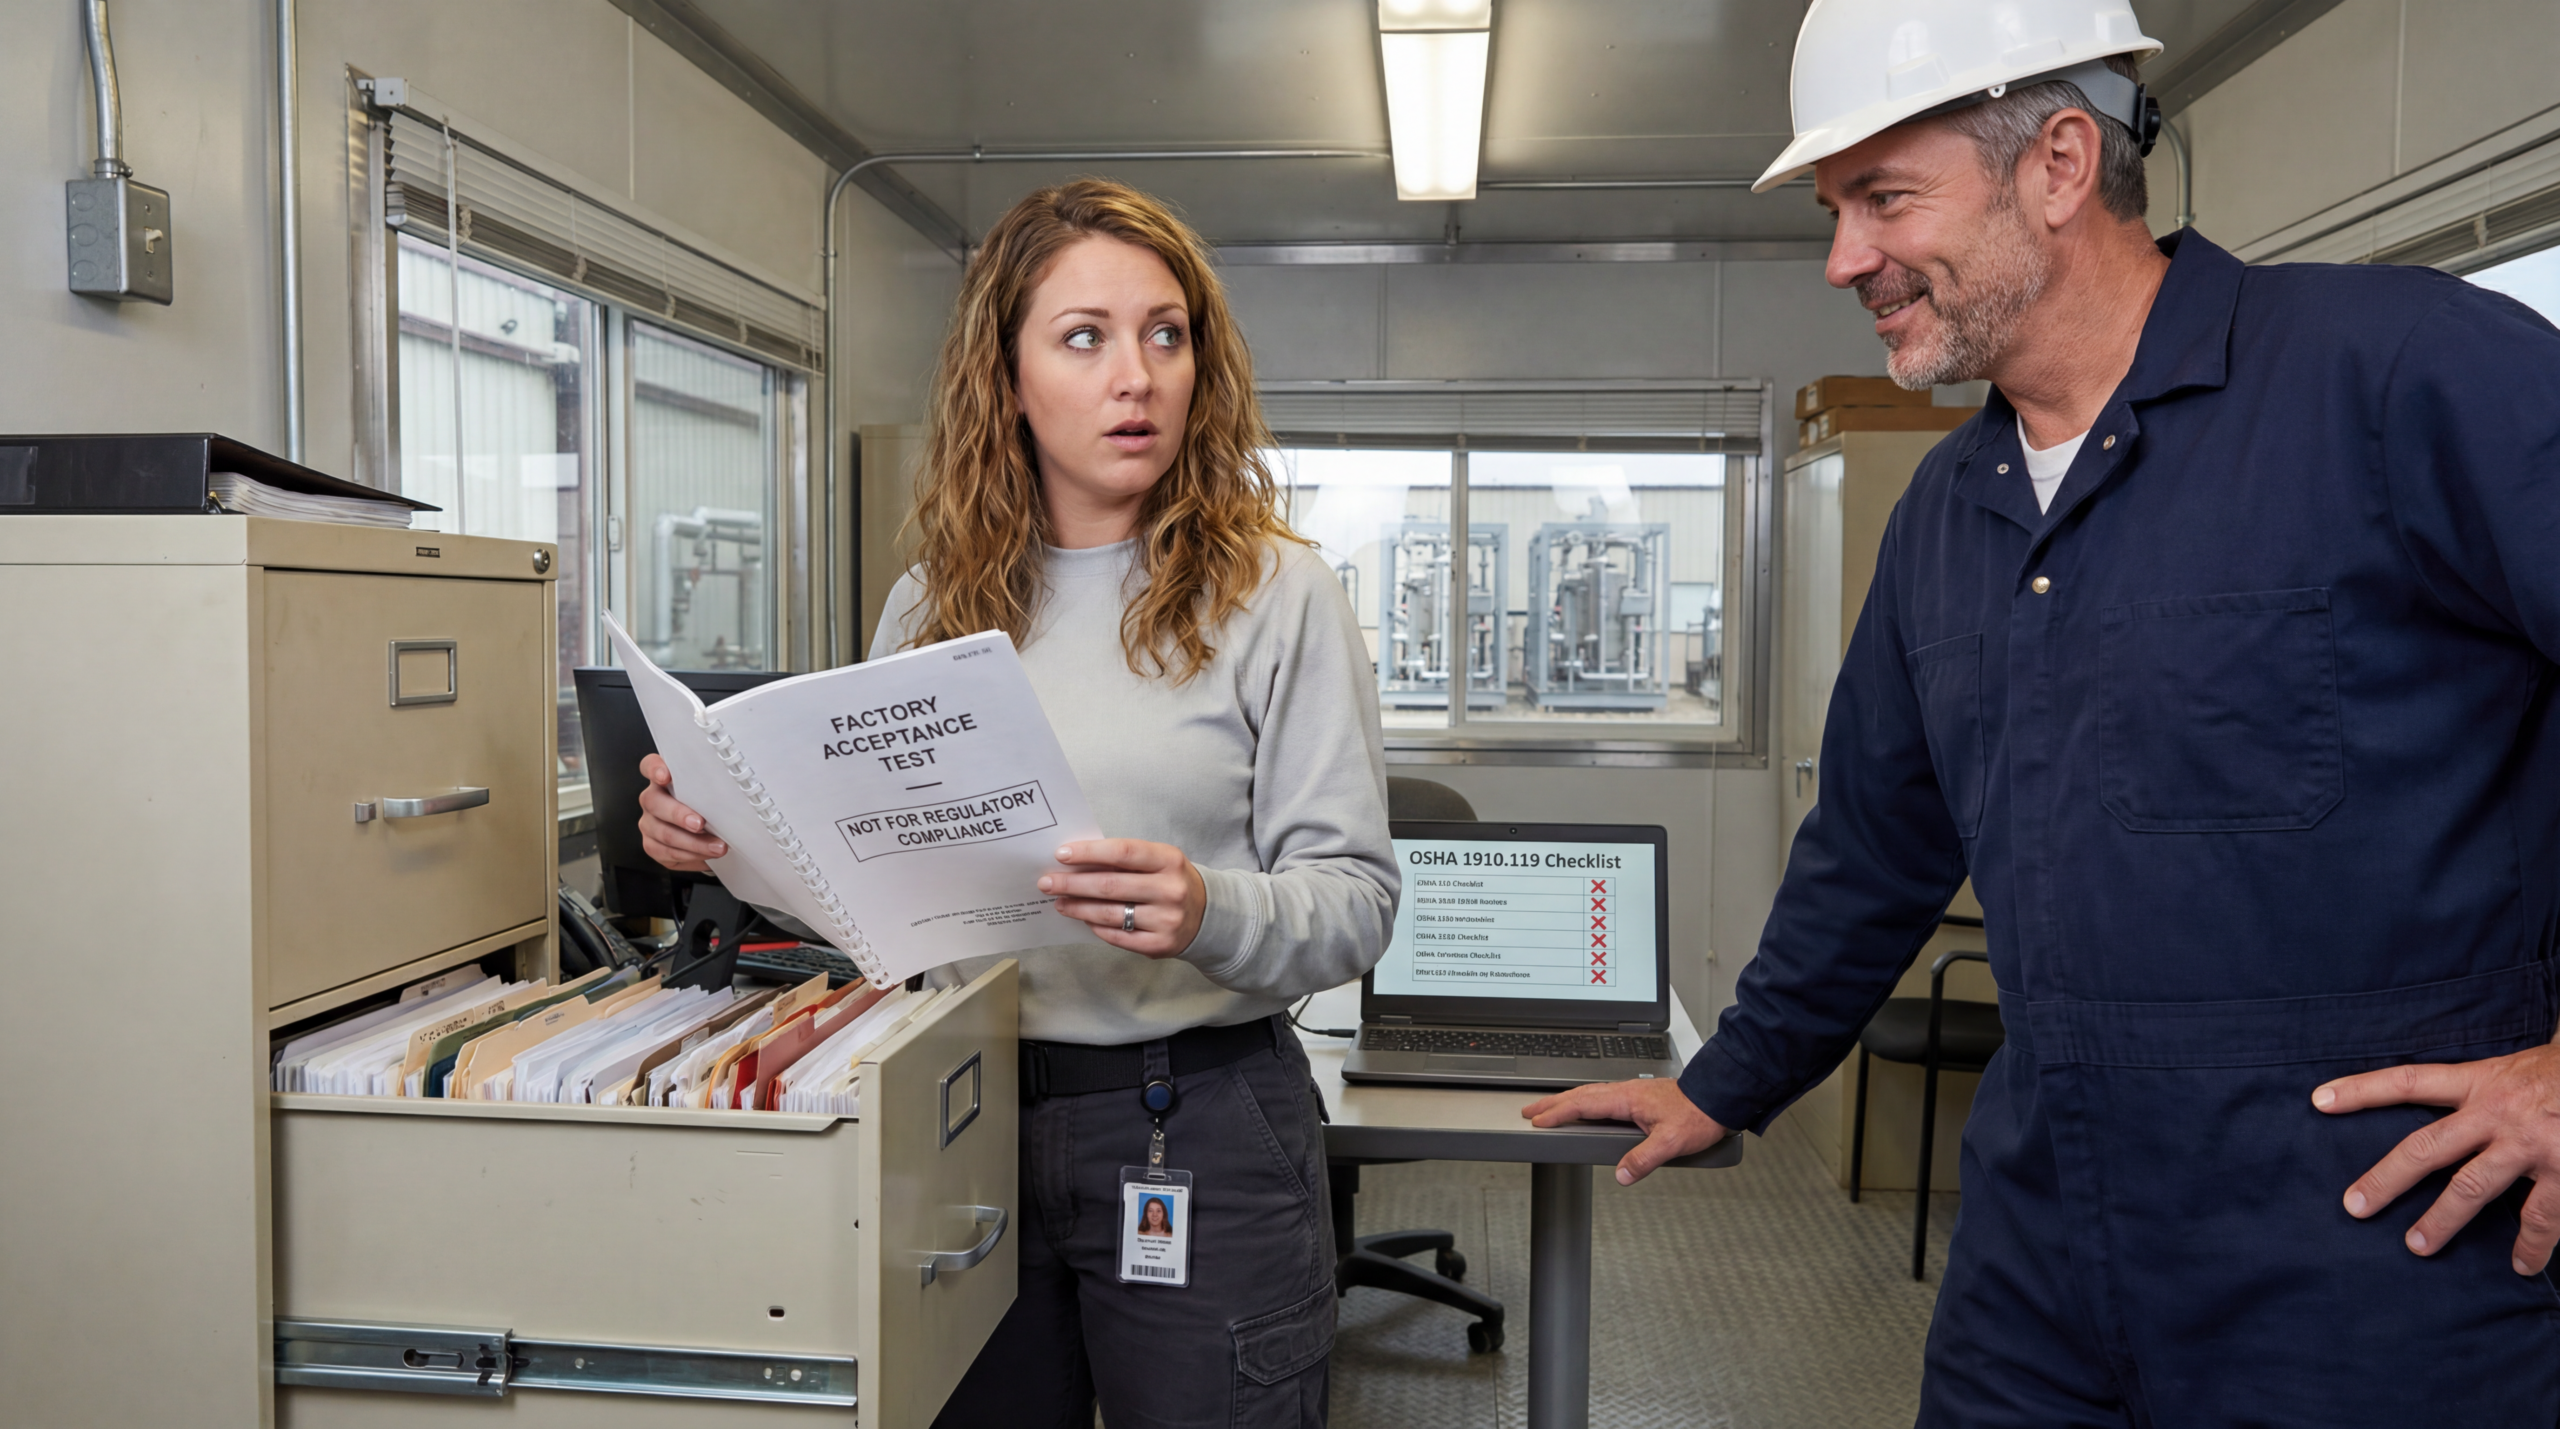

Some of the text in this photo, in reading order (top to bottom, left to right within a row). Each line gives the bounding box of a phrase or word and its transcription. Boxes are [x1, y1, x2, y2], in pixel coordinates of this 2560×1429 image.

[830, 695, 937, 734] FACTORY
[823, 713, 978, 760] ACCEPTANCE
[878, 748, 936, 772] TEST
[847, 788, 1035, 837] NOT FOR REGULATORY
[897, 817, 1007, 846] COMPLIANCE
[1409, 850, 1622, 869] OSHA 1910.119 Checklist
